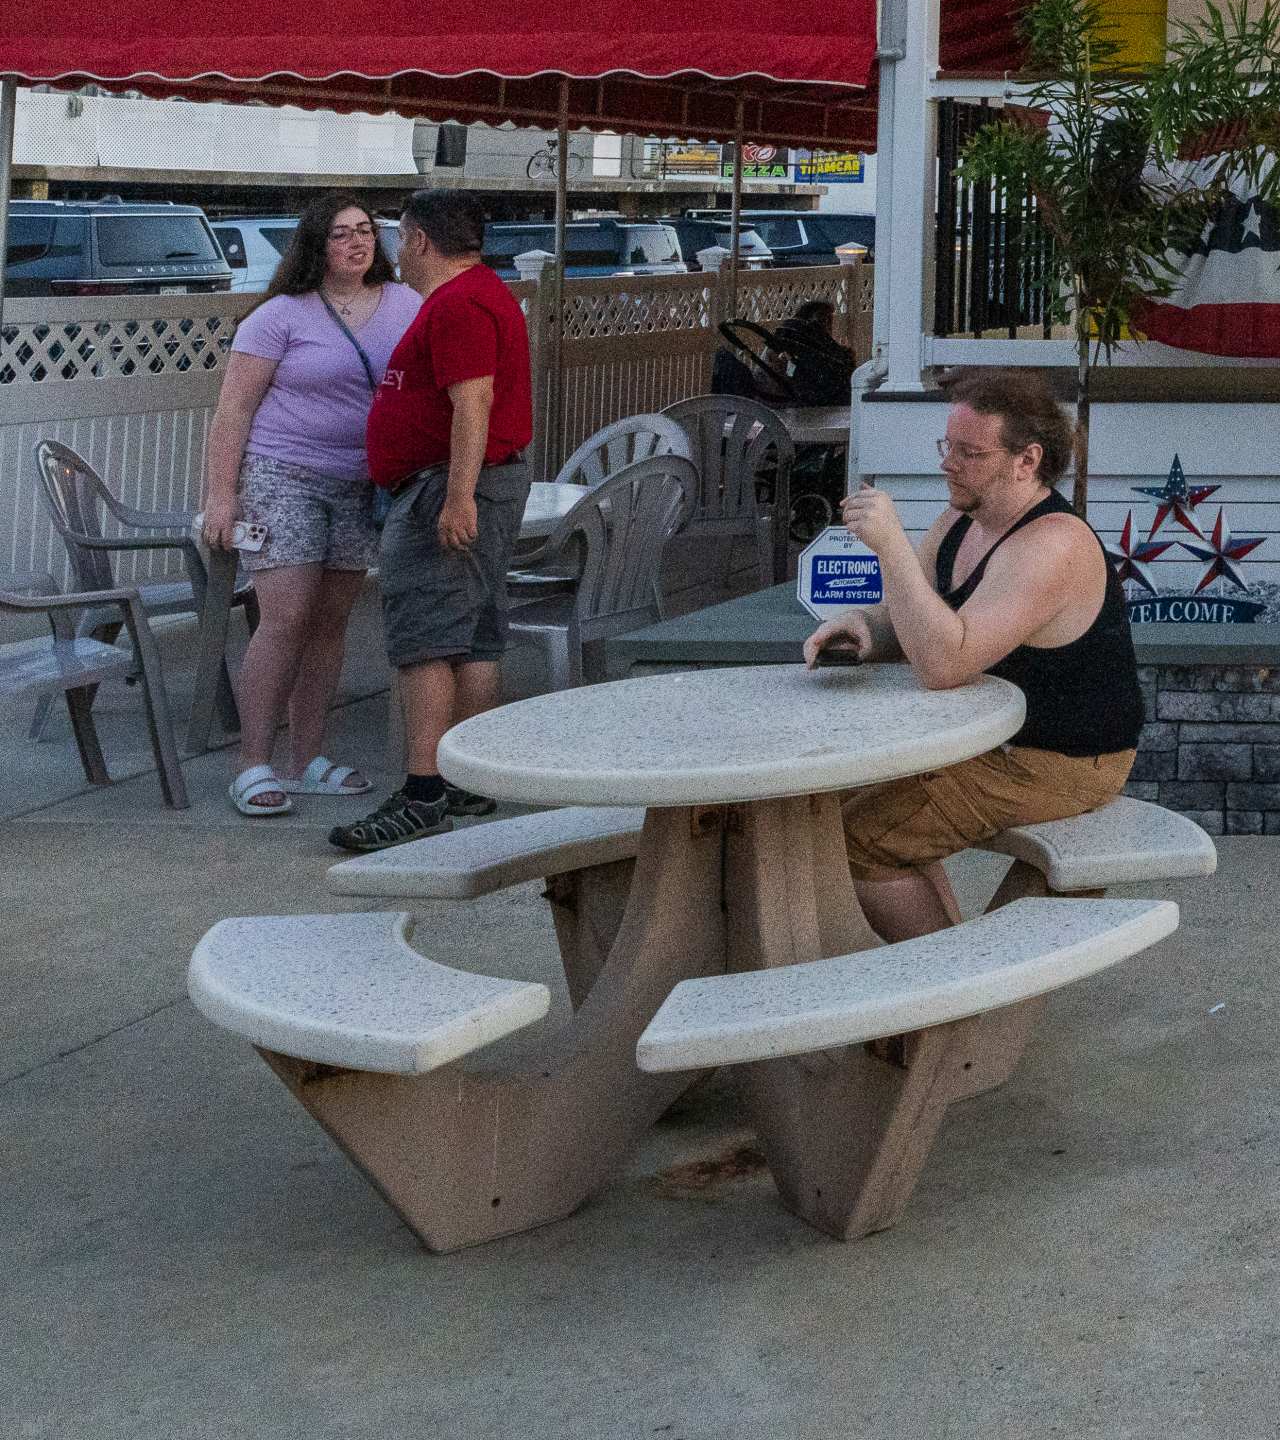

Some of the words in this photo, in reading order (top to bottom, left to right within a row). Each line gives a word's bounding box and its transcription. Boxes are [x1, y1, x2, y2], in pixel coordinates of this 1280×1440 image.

[723, 163, 786, 177] PZZA
[817, 560, 878, 575] ELECTRONIC
[832, 578, 865, 586] AUTOMATIC
[813, 590, 844, 599] ALARM
[845, 590, 880, 599] SYSTEM
